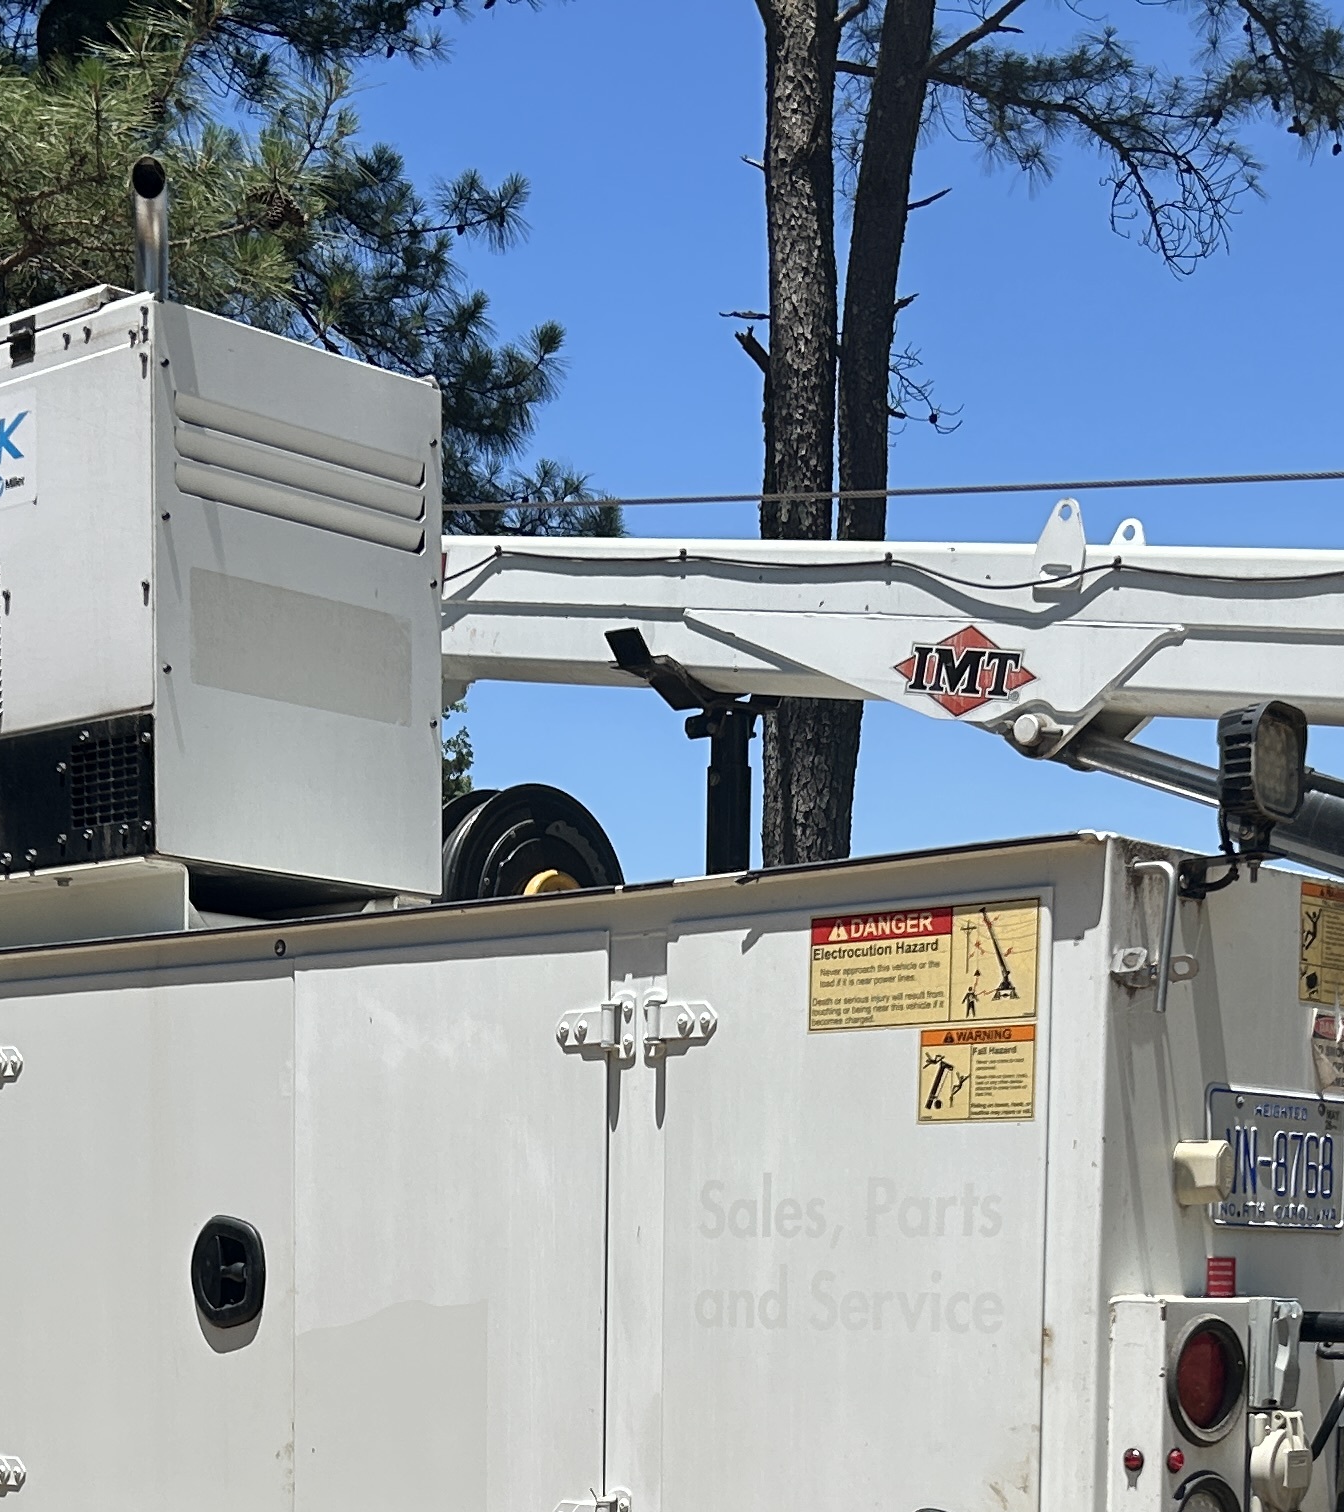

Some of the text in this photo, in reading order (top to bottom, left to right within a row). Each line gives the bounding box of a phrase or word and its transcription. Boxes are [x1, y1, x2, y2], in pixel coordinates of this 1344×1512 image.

[906, 644, 1023, 699] IMT
[849, 911, 934, 938] DANGER
[812, 938, 939, 961] Electrocution Hazard
[955, 1028, 1013, 1042] WARNING
[972, 1045, 1017, 1056] Fall Hazard
[1254, 1103, 1307, 1120] WEIGHTED
[698, 1172, 1004, 1249] Sales, Parts
[694, 1263, 1004, 1334] and Service
